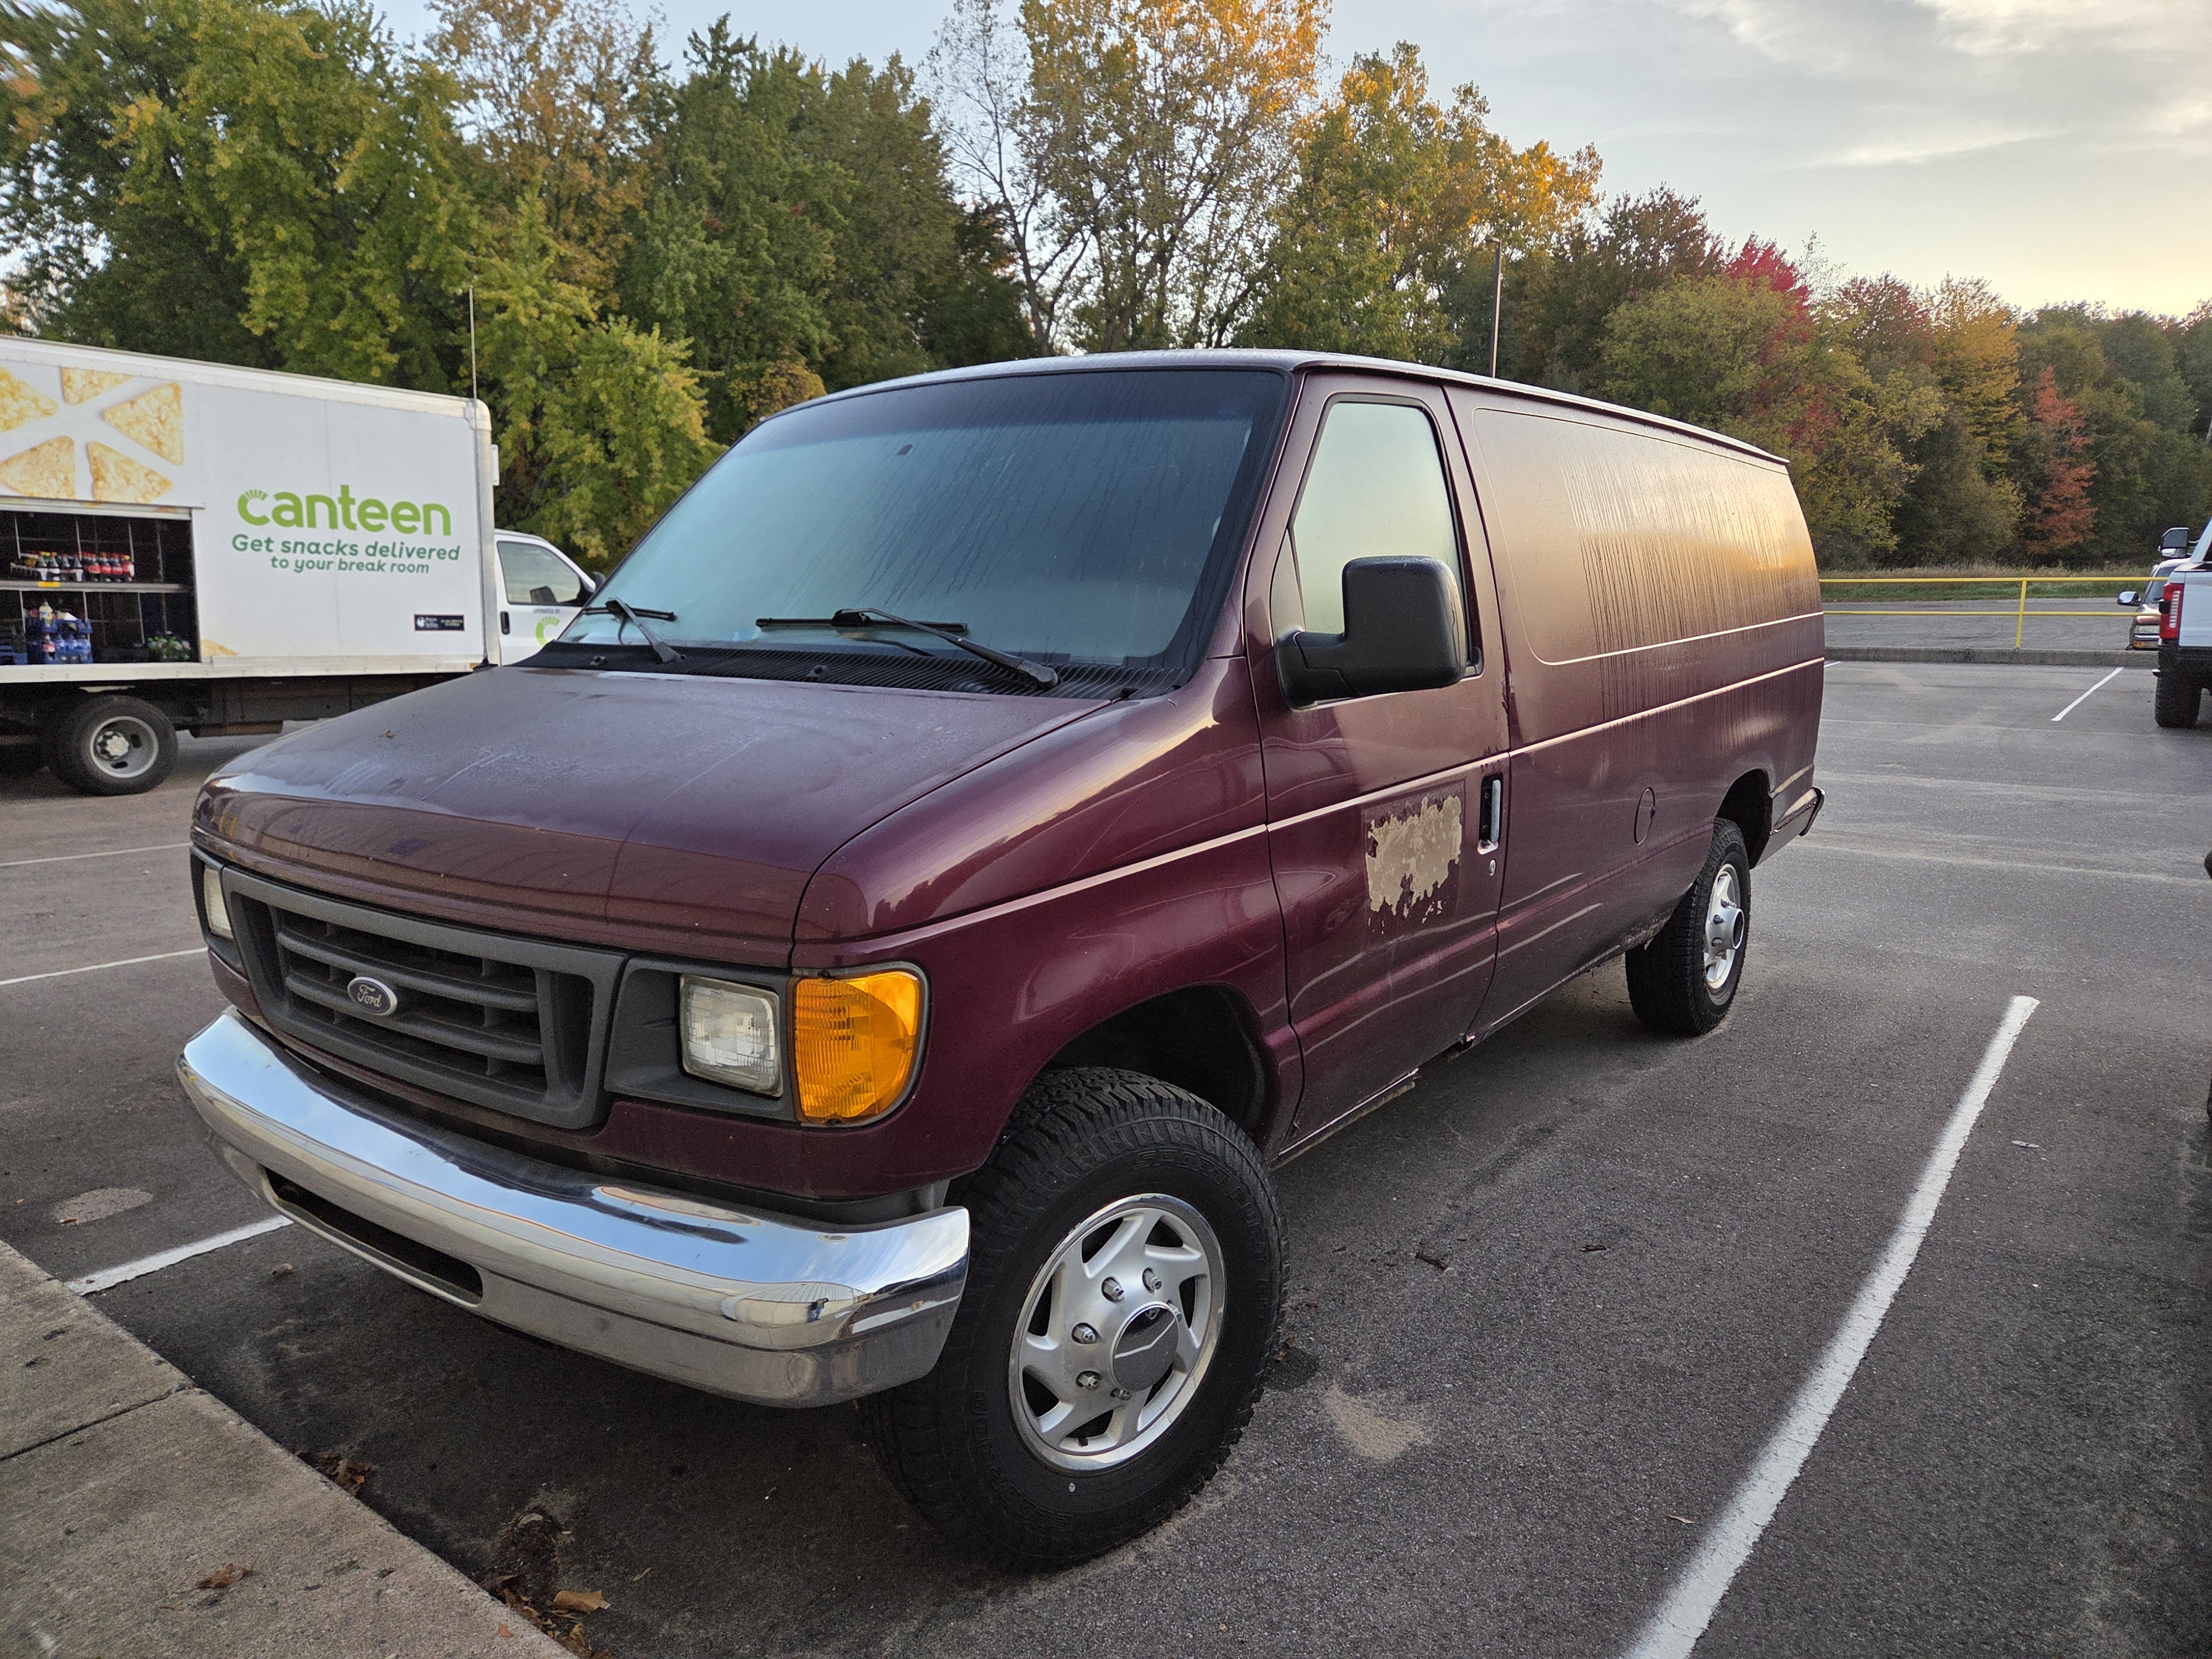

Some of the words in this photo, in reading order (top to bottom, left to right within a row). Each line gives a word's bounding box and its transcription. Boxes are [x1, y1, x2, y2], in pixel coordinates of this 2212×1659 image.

[237, 484, 451, 536] canteen
[232, 534, 274, 552] Get
[280, 539, 359, 556] snacks
[365, 541, 460, 560] delivered
[270, 556, 289, 569] to
[294, 559, 333, 573] your
[337, 557, 387, 573] break
[390, 562, 430, 574] room
[357, 984, 382, 1008] Ford
